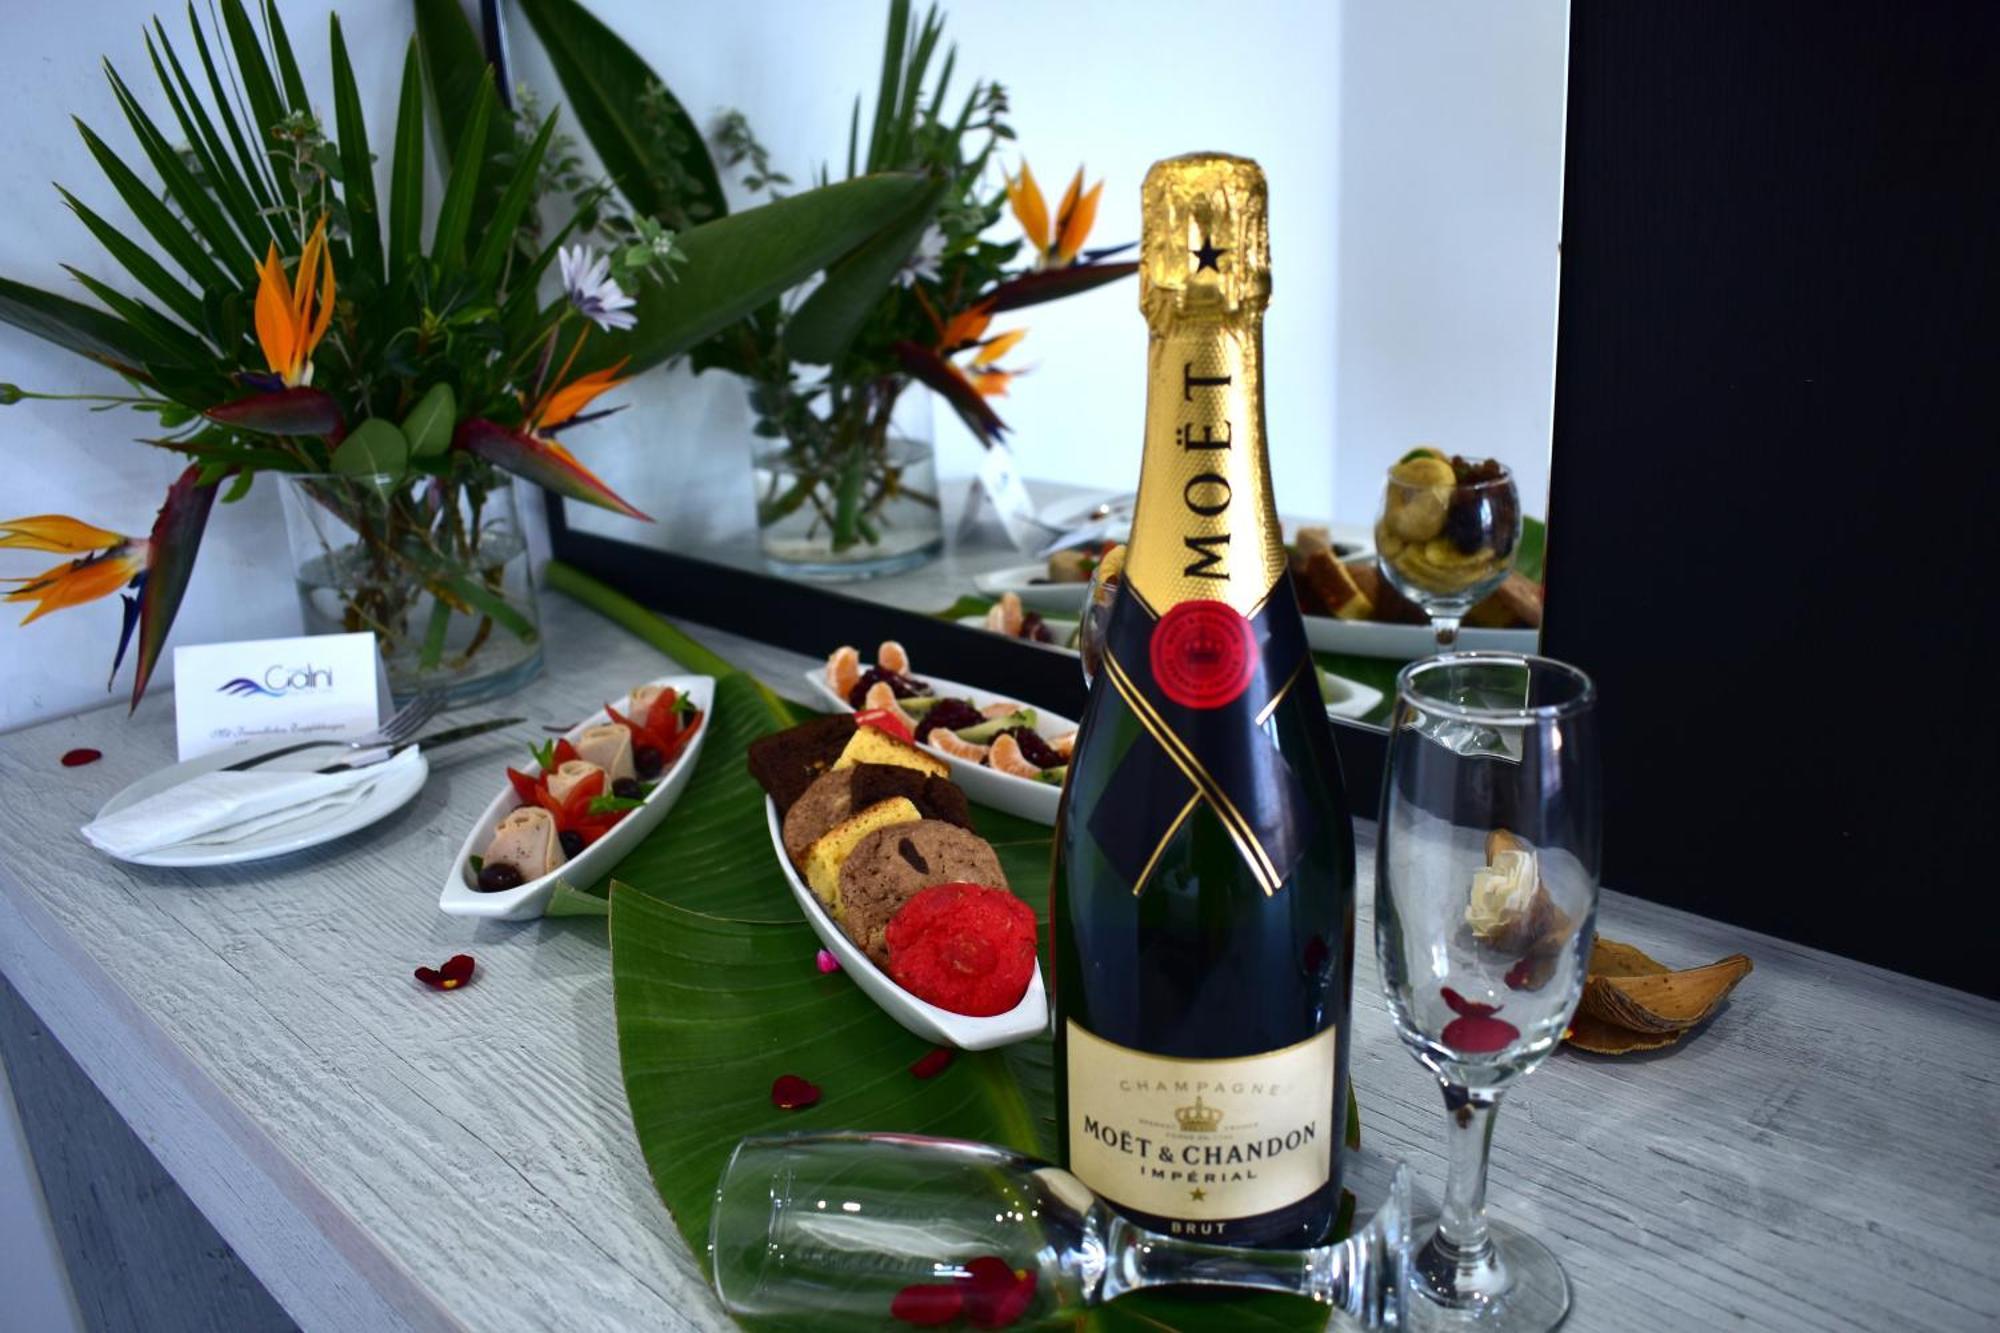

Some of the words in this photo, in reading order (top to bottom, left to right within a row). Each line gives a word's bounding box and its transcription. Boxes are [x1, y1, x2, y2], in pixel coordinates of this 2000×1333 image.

[1175, 361, 1233, 582] MOËT
[1119, 1078, 1281, 1097] CHAMPAGNE
[1157, 1145, 1175, 1165] &
[1182, 1120, 1318, 1166] CHANDON
[1140, 1164, 1258, 1184] IMPÉRIAL
[1170, 1220, 1227, 1235] BRUT
